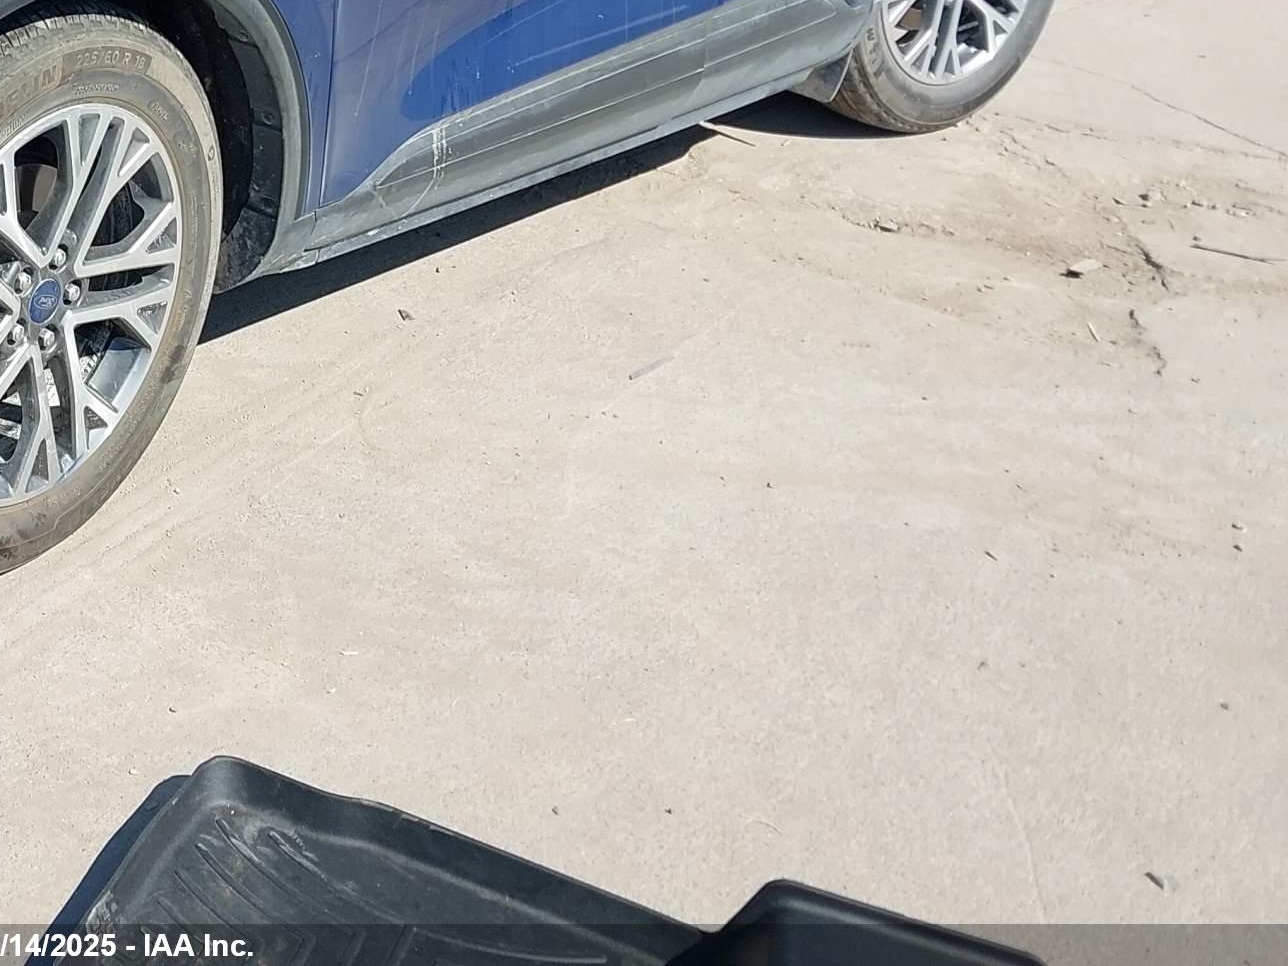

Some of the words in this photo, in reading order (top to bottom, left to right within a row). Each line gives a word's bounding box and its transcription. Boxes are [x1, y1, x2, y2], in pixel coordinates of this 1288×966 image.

[76, 49, 120, 68] 225/60
[122, 52, 132, 65] R
[134, 55, 146, 69] 18
